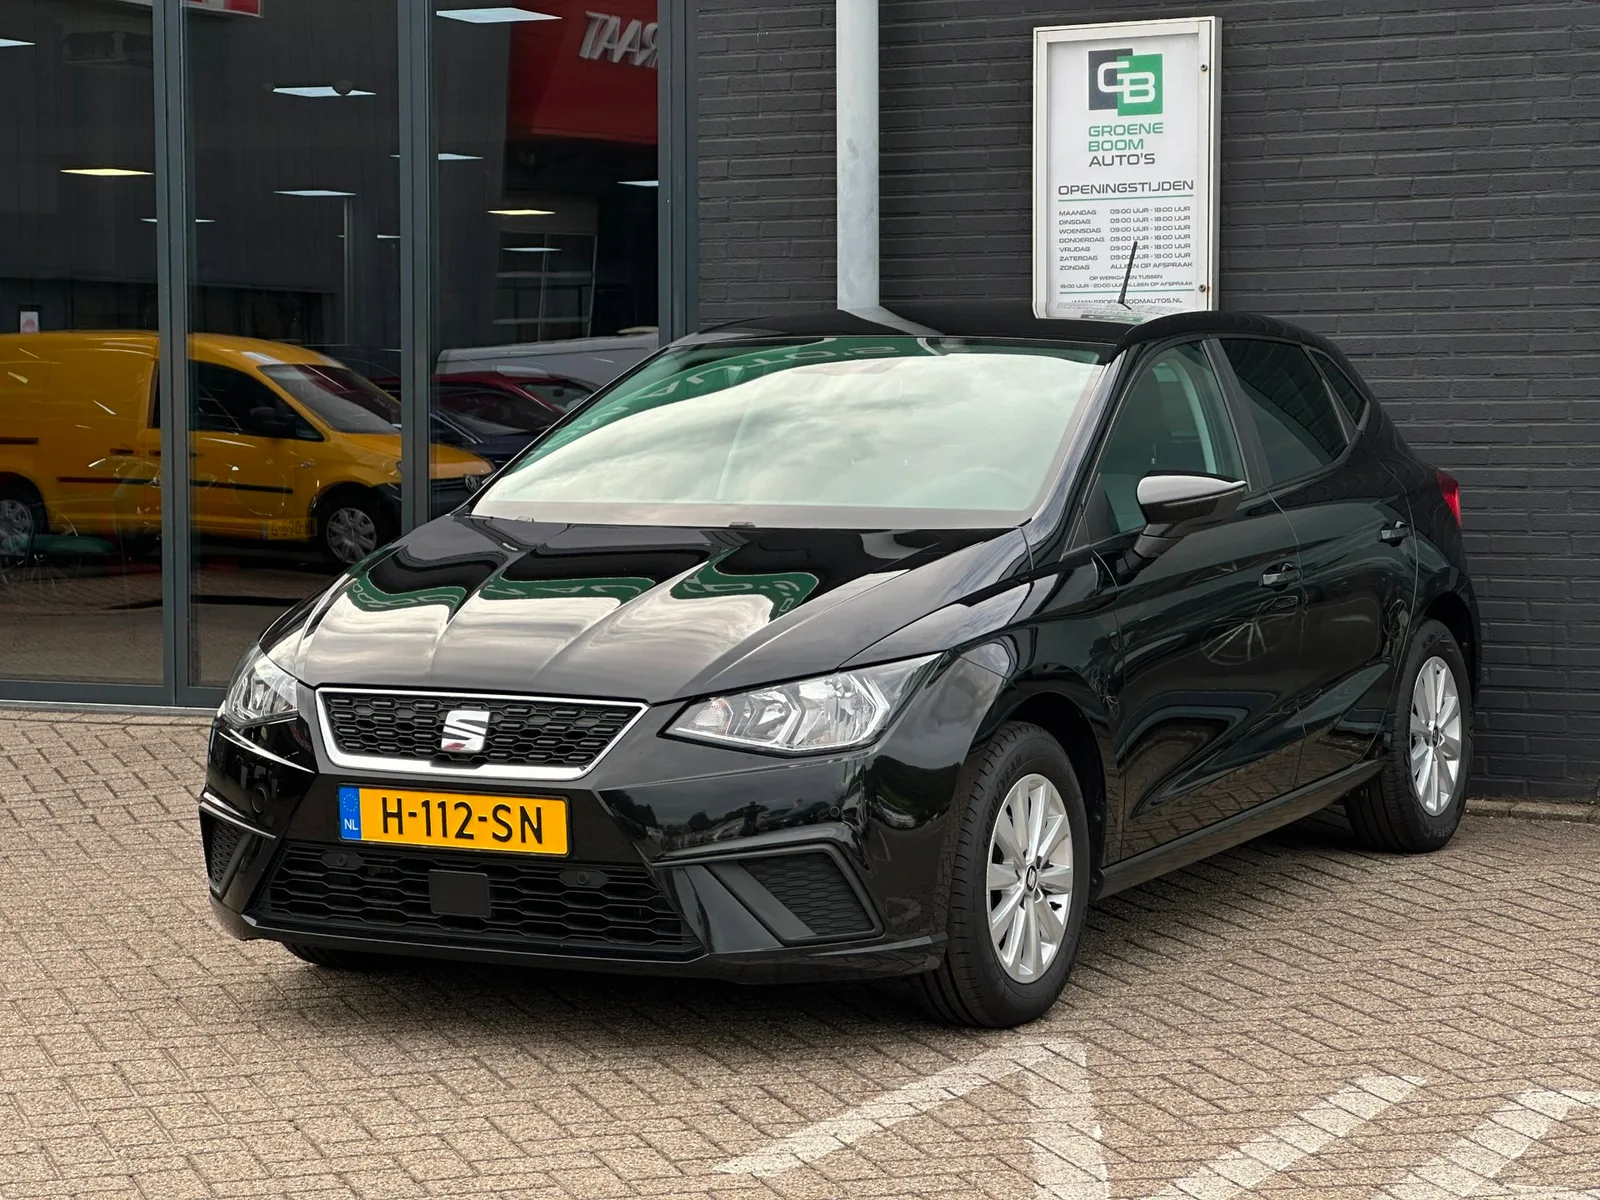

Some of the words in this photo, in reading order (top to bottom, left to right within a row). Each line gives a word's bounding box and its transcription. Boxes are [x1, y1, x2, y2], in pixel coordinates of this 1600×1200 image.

[1088, 122, 1164, 137] GROENE
[1088, 139, 1144, 153] BOOM
[1088, 153, 1156, 168] AUTO'S
[1058, 180, 1194, 196] OPENINGSTIJDEN
[344, 818, 359, 831] NL
[381, 796, 543, 845] H-112-SN
